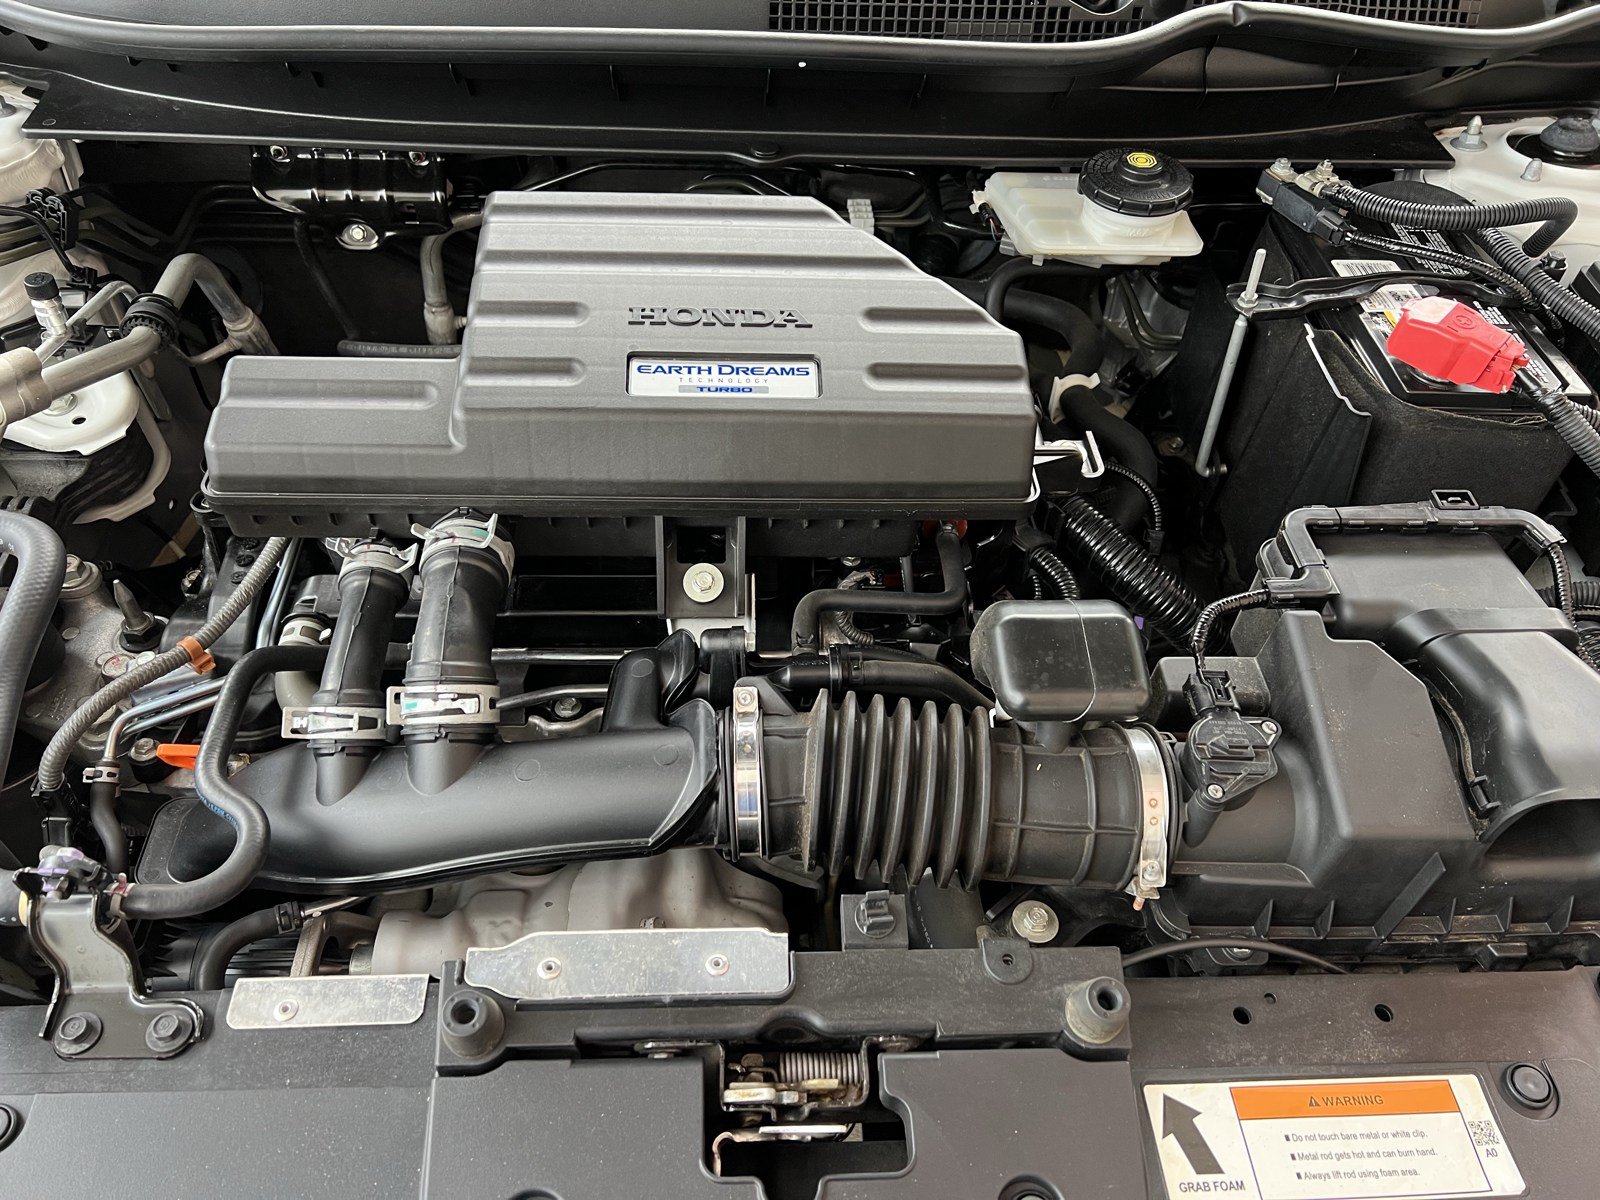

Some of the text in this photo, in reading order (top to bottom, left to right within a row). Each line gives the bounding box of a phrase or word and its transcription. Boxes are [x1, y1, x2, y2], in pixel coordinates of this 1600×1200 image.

[628, 307, 813, 328] HONDA
[637, 364, 810, 376] EARTH DREAMS
[1322, 1095, 1384, 1106] WARNING
[1292, 1129, 1428, 1142] Do not touch bare metal or white clip.
[1297, 1147, 1438, 1162] Metal rod gets hot and can burn hand.
[1486, 1148, 1498, 1158] A0
[1304, 1168, 1420, 1182] Always lift rod using foam area.
[1179, 1180, 1246, 1193] GRAB FOAM
